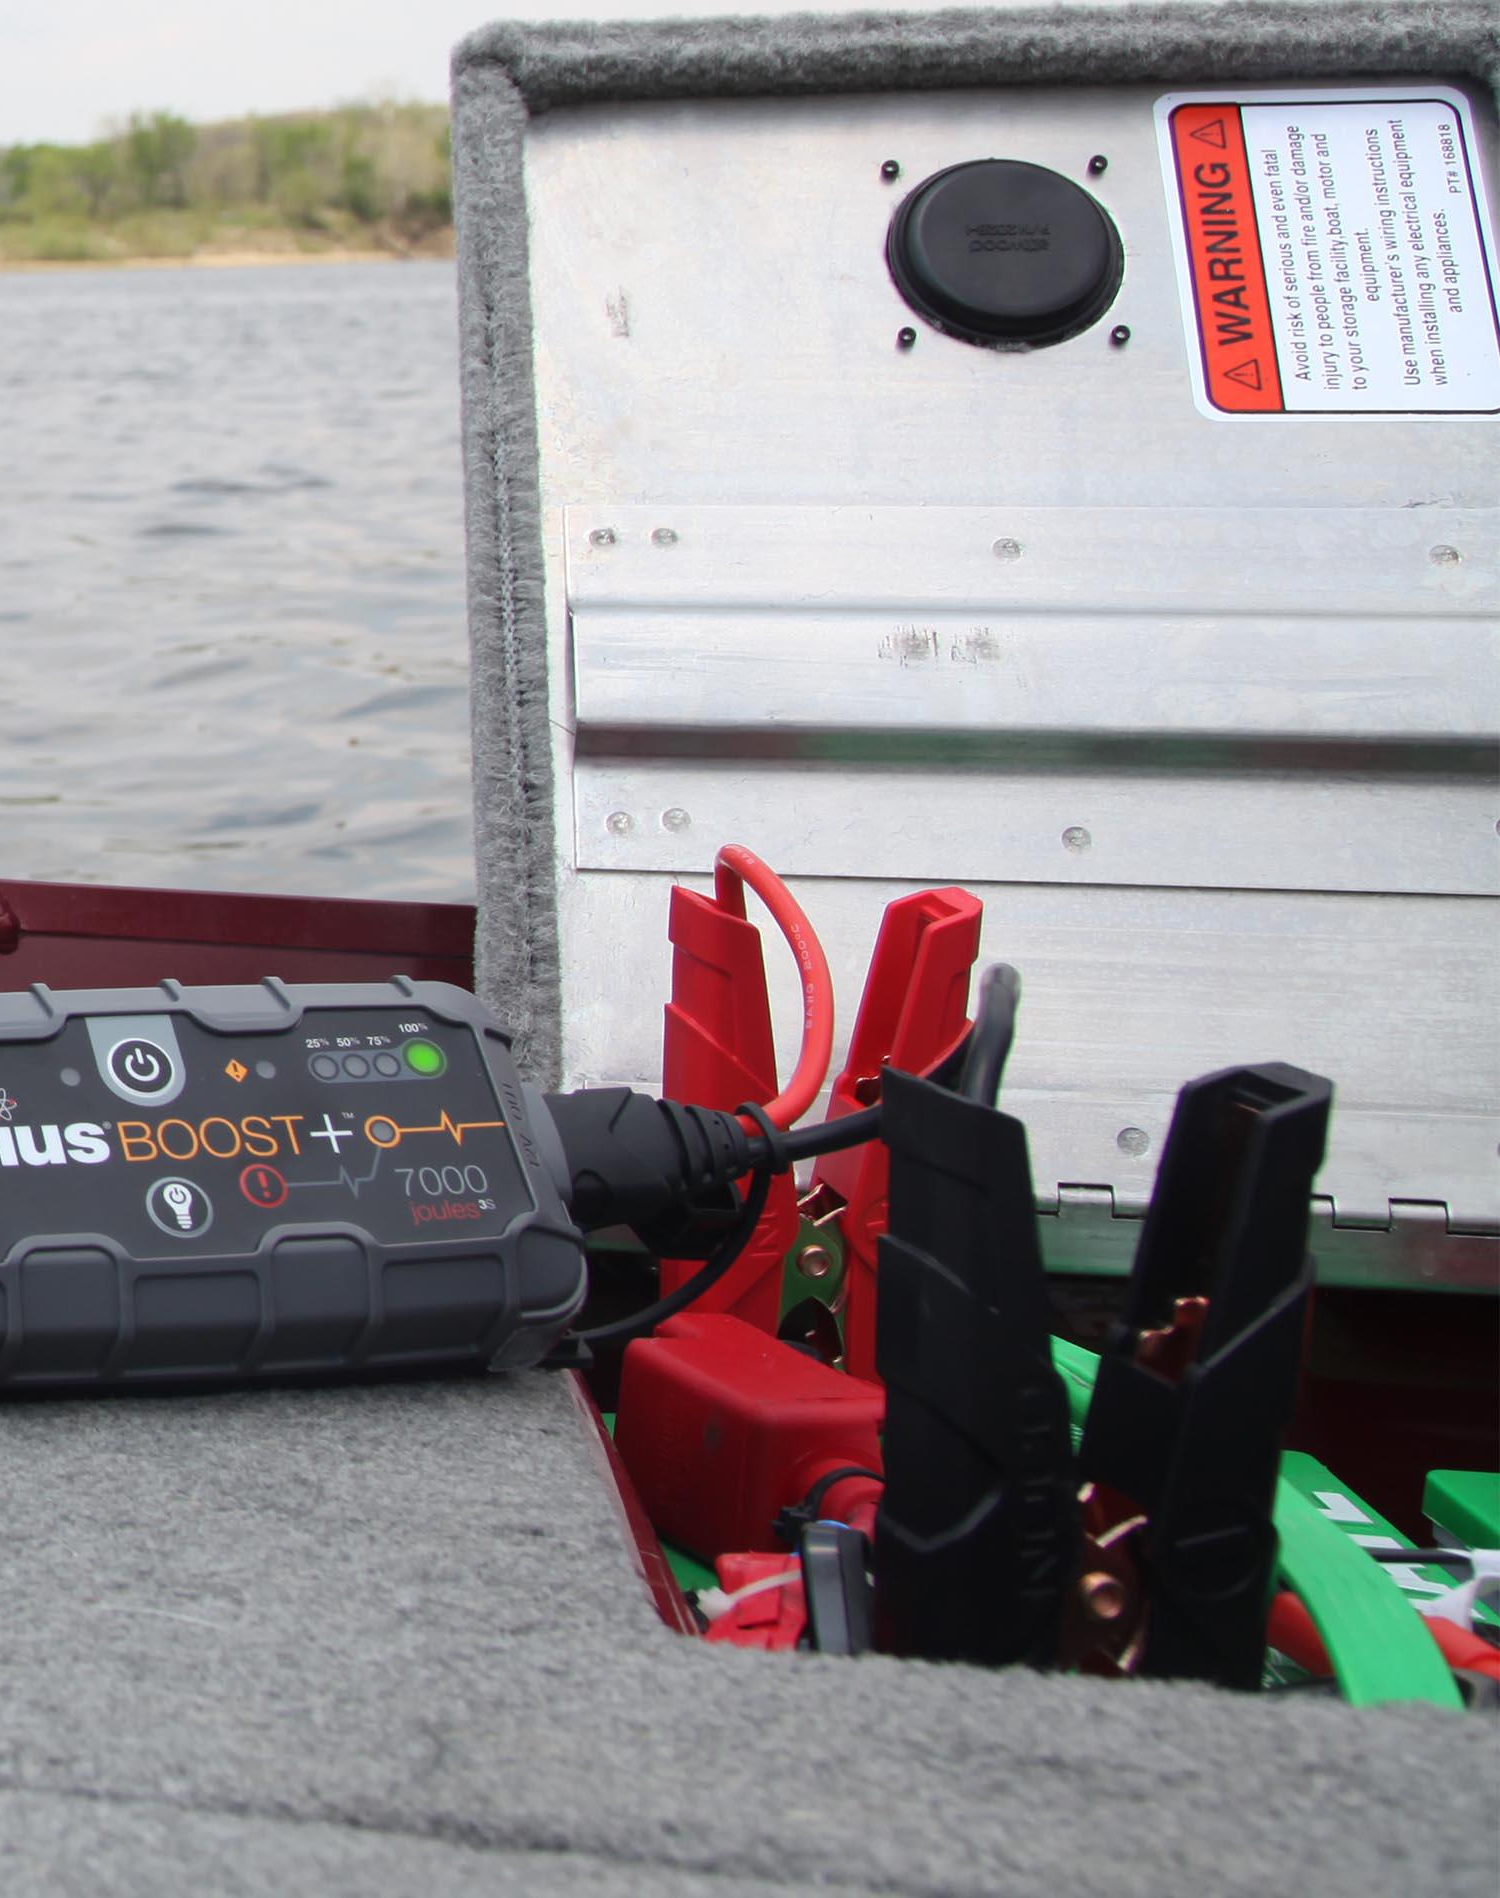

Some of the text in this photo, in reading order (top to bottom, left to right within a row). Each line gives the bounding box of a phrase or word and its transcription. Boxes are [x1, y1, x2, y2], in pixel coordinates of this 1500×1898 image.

[1311, 133, 1329, 157] and
[1438, 124, 1462, 193] PT# 168818
[1318, 161, 1336, 199] motor
[1194, 162, 1254, 346] WARNING
[1261, 149, 1311, 381] Avoid risk of serious and even fatal
[1287, 126, 1343, 390] injury to people from fire and/or damage
[1354, 228, 1382, 302] equipment.
[1366, 128, 1421, 385] Use manufacturer's wiring instructions
[1387, 119, 1448, 386] when installing any electrical equipment
[1433, 208, 1463, 313] and appliances.
[1339, 287, 1359, 337] storage
[1348, 342, 1369, 372] your
[1352, 376, 1367, 390] to
[305, 1022, 428, 1049] 25% 50% 75% 100%
[394, 1165, 488, 1196] 7000
